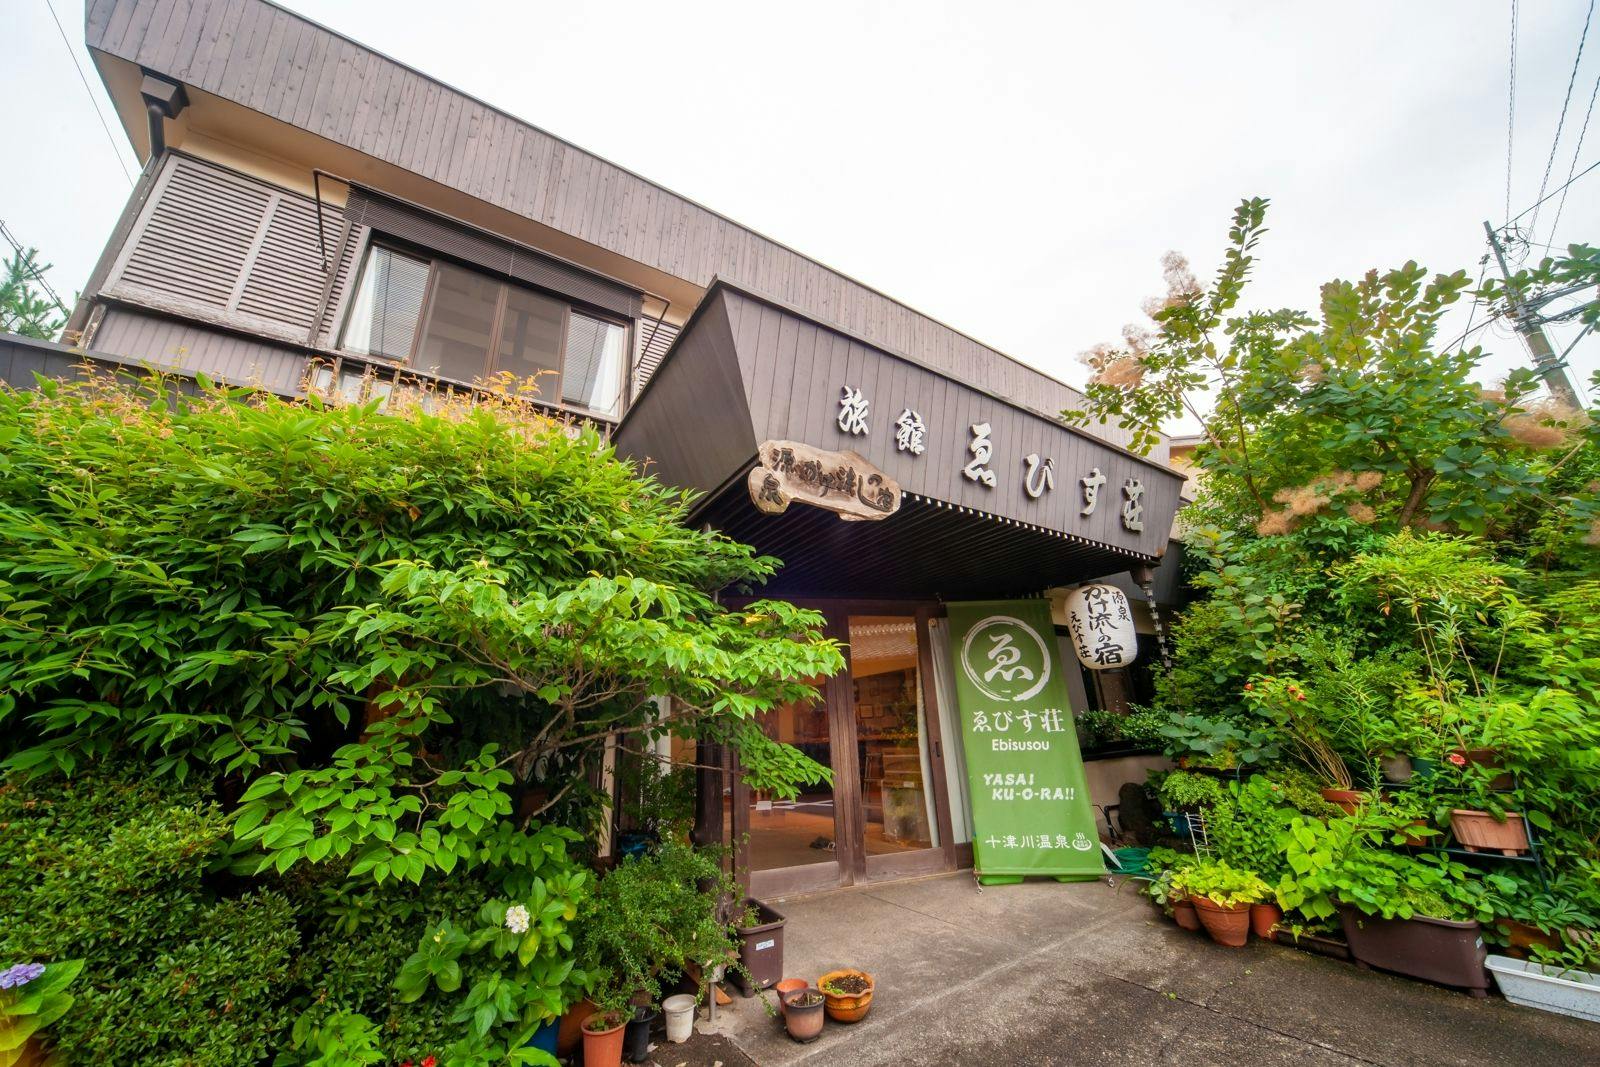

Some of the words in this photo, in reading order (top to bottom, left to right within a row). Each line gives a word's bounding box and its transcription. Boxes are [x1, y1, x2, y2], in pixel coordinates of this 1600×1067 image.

[973, 709, 1065, 734] ゑびす荘
[992, 738, 1050, 751] Ebisusou
[992, 787, 1074, 801] KU-O-RA!!
[985, 834, 1071, 849] 十津川温泉
